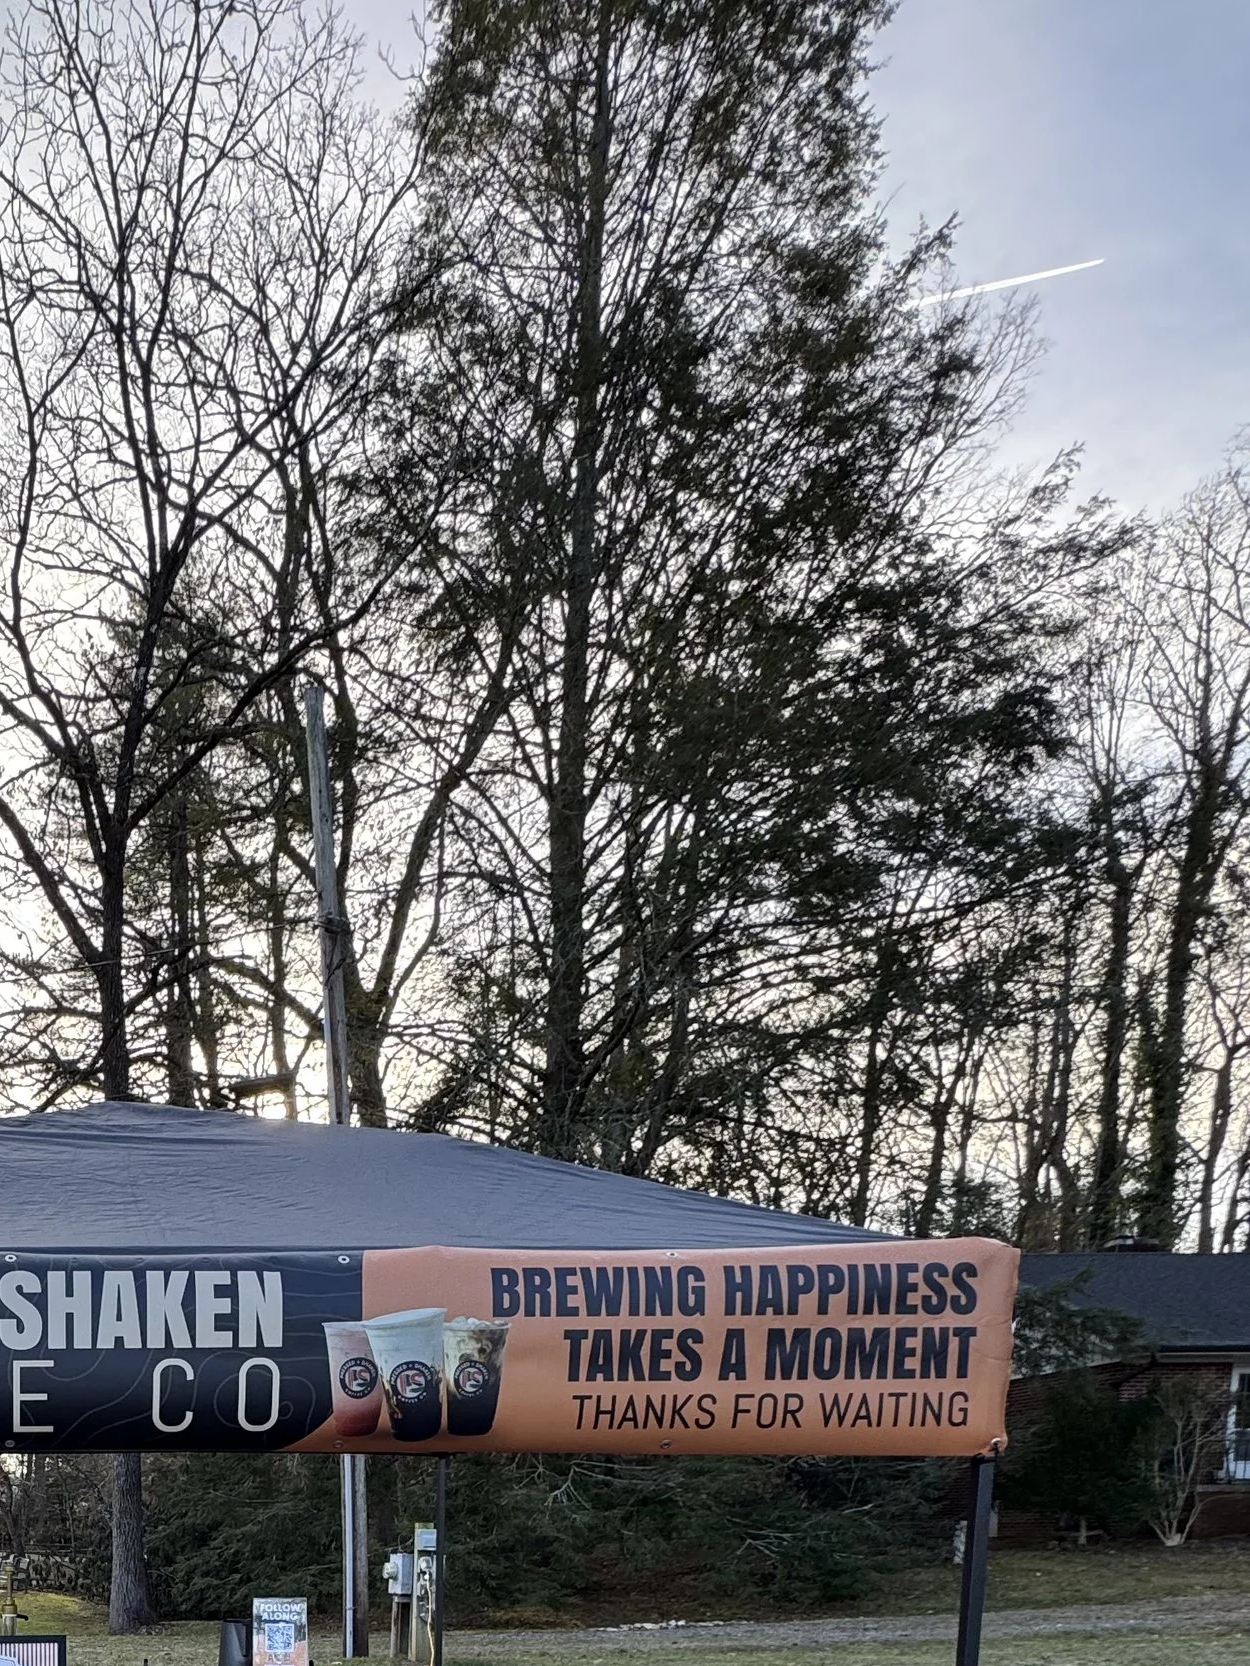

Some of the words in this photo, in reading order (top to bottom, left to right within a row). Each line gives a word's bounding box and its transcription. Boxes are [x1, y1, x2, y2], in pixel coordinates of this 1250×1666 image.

[490, 1265, 706, 1318] BREWING
[723, 1262, 977, 1316] HAPPINESS
[563, 1329, 704, 1382] TAKES
[718, 1329, 752, 1382] A
[764, 1327, 977, 1381] MOMENT
[151, 1357, 282, 1433] CO
[573, 1394, 717, 1430] THANKS
[733, 1393, 803, 1429] FOR
[817, 1391, 970, 1428] WAITING
[260, 1603, 301, 1612] FOLLOW
[262, 1612, 298, 1620] ALONG
